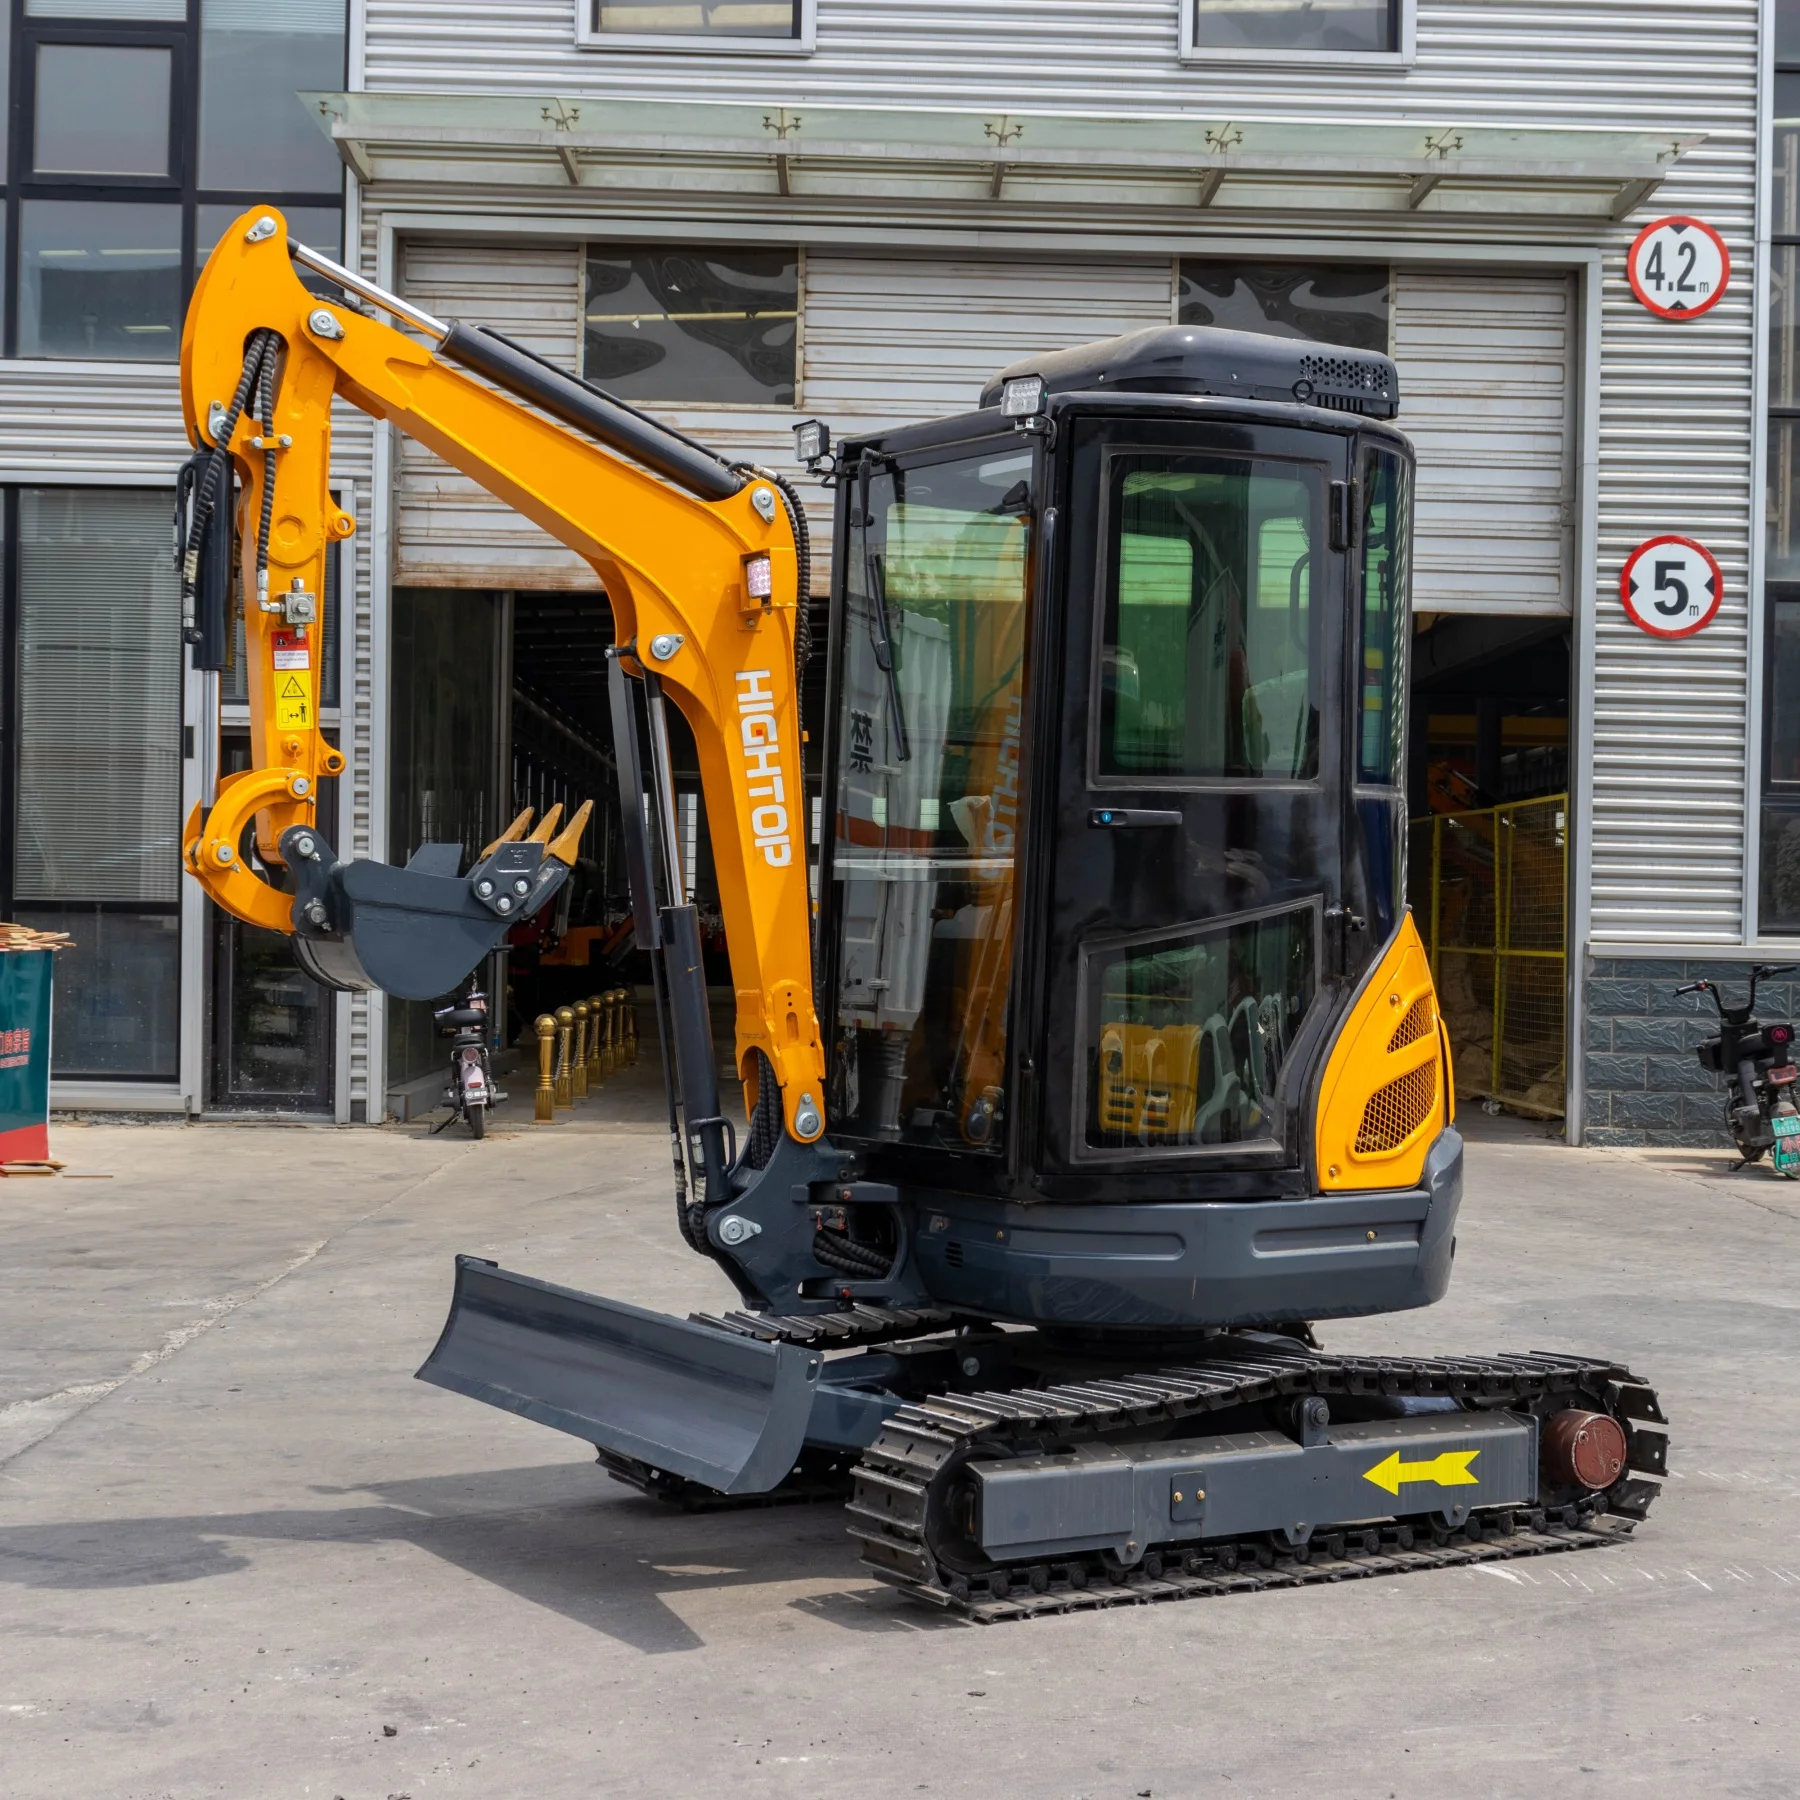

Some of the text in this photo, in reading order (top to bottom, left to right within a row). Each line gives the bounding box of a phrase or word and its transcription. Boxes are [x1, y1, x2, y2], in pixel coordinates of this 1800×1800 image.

[1645, 241, 1709, 293] 4.2 m
[1654, 560, 1699, 616] 5 m
[735, 669, 792, 868] HIGHTOP
